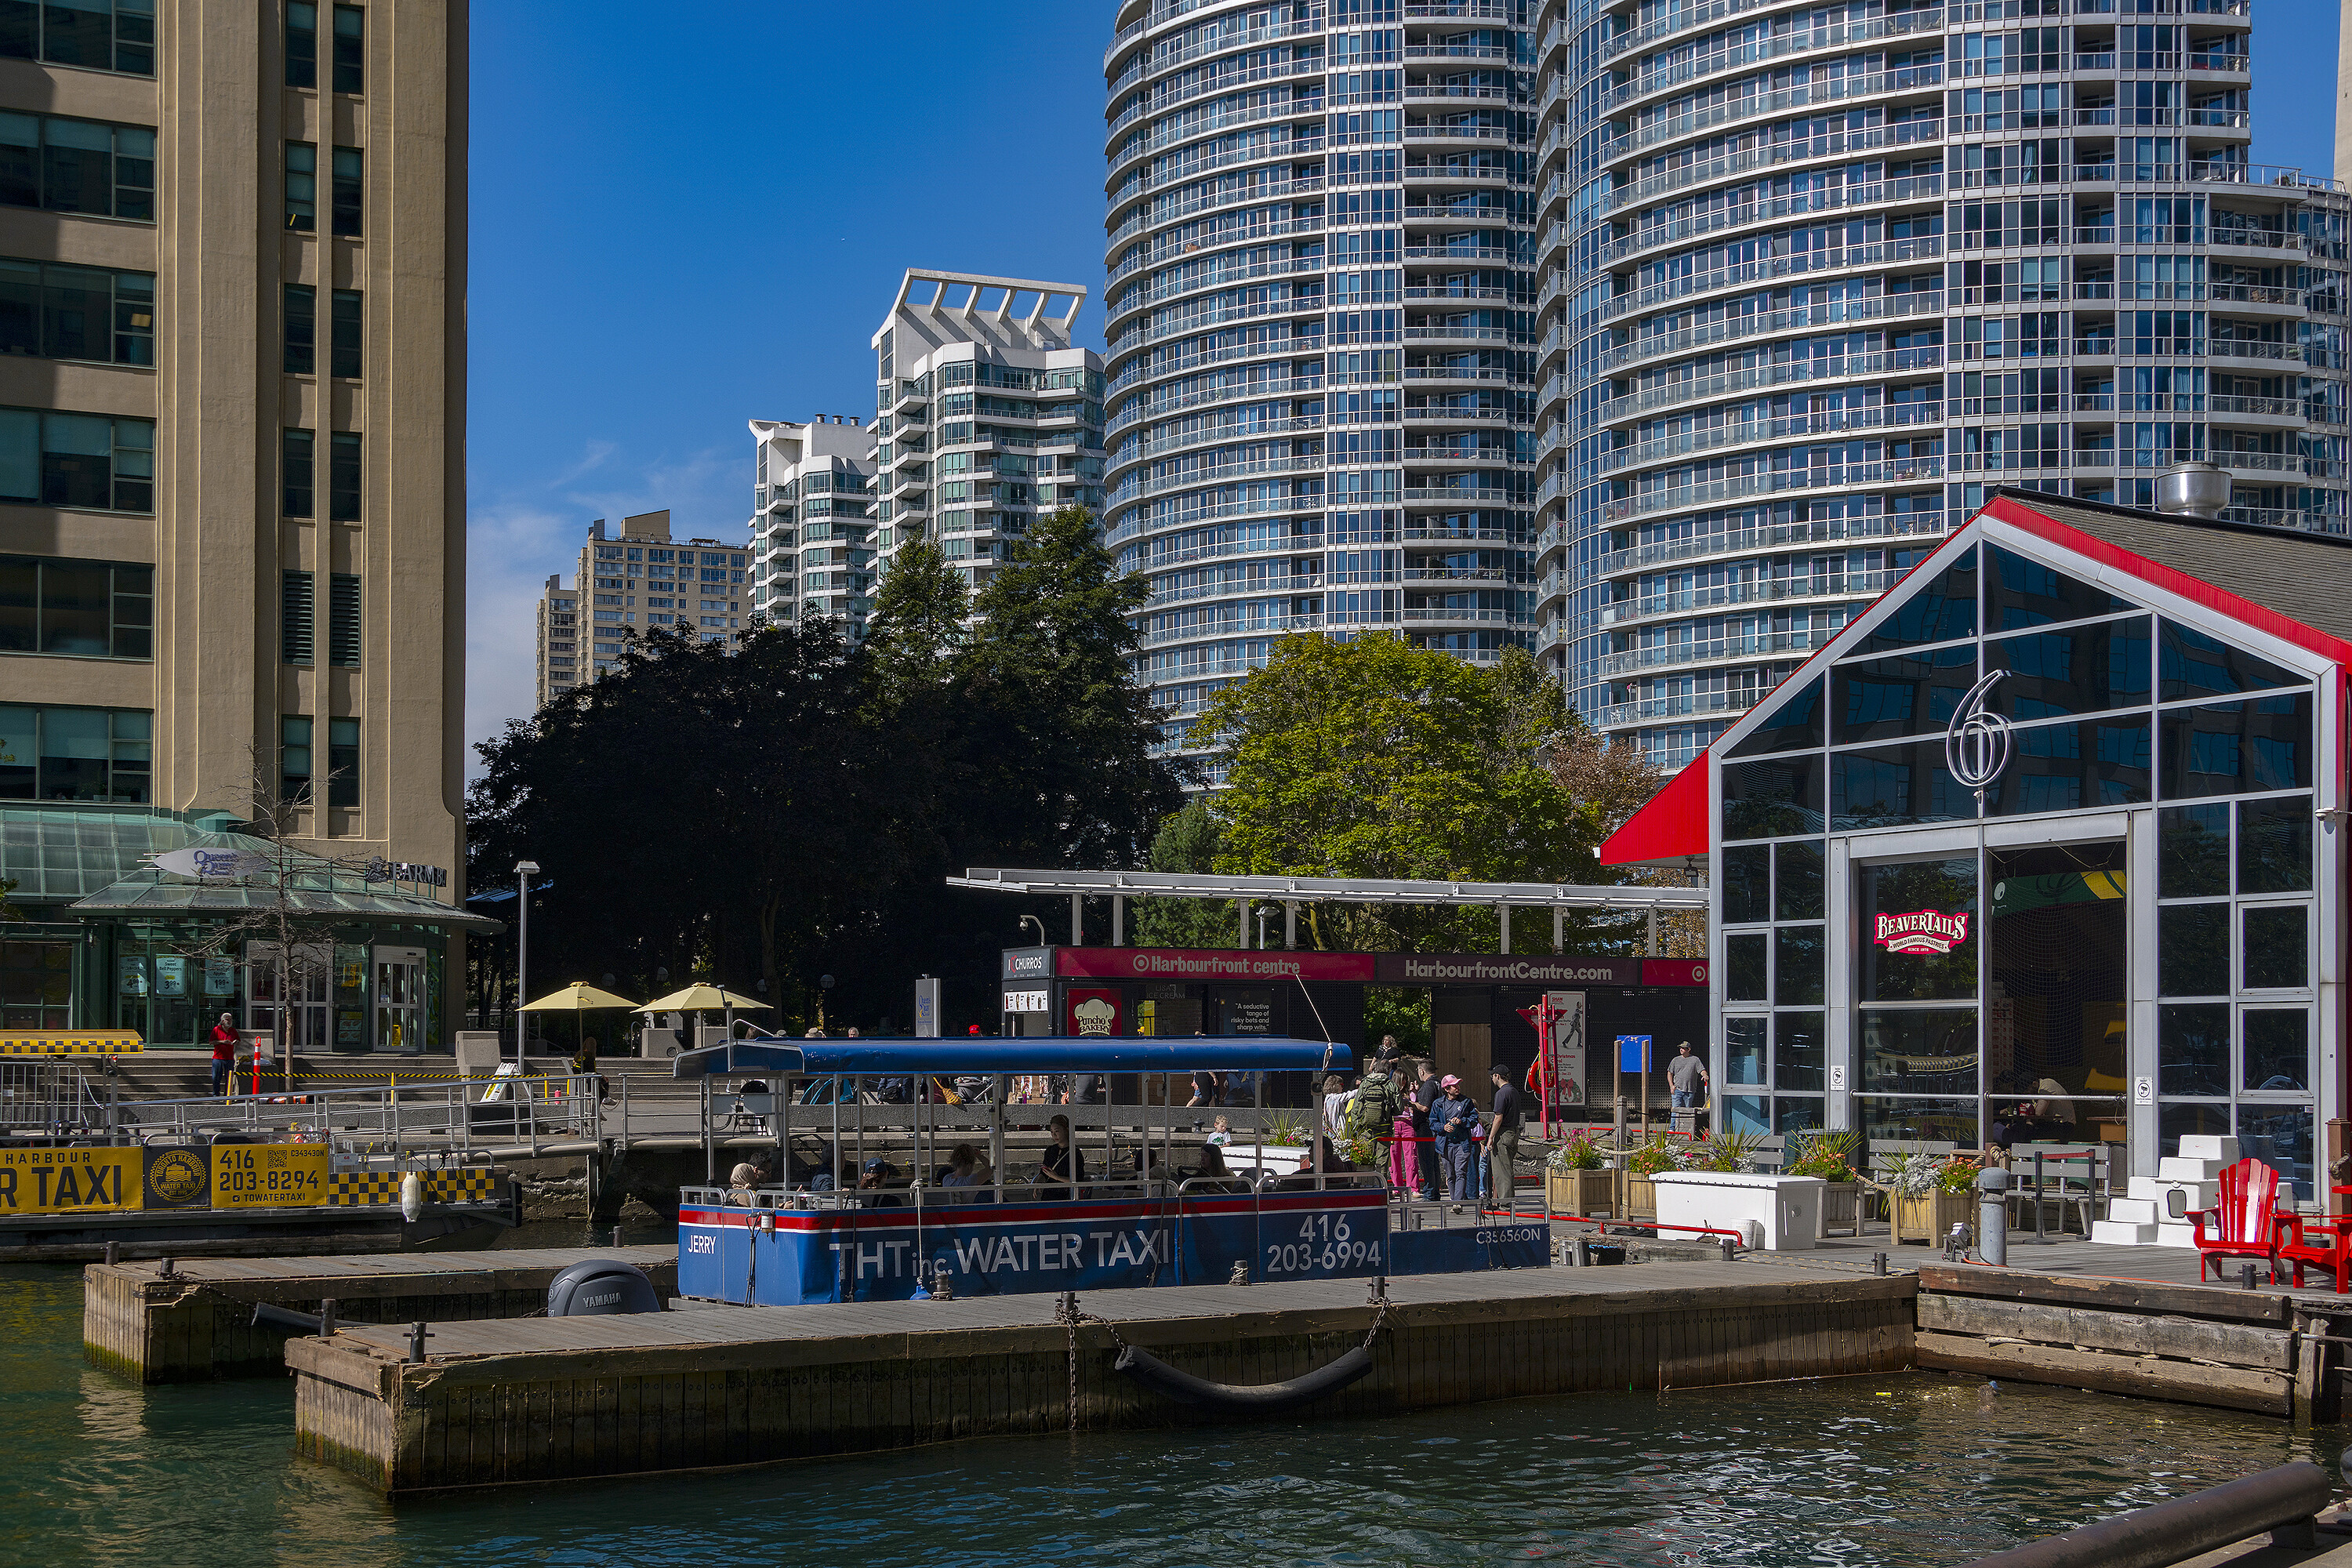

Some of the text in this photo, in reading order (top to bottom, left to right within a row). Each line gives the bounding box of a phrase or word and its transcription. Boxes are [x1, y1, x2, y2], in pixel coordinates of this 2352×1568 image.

[1946, 669, 2012, 786] 6
[1893, 939, 1907, 949] WORLD
[1926, 938, 1944, 949] PASTRIES
[1015, 956, 1042, 971] CHURROS
[1152, 956, 1301, 974] Harbourfront centre
[1406, 960, 1613, 980] HarbourfrontCentre.com
[1077, 1014, 1112, 1027] Pancho's
[1079, 1025, 1111, 1033] BAKERY
[5, 1152, 91, 1164] HARBOUR
[156, 1155, 201, 1177] TORONTO HARBOUR
[220, 1149, 254, 1169] 416
[31, 1165, 122, 1207] TAXI
[220, 1170, 319, 1191] 203-8294
[244, 1192, 306, 1202] TOWATERTAXI
[1299, 1214, 1350, 1242] 416
[688, 1235, 717, 1254] JERRY
[829, 1229, 1169, 1279] THT inc. WATER TAXI
[1267, 1240, 1381, 1272] 203-6994
[583, 1292, 622, 1308] YAMAHA
